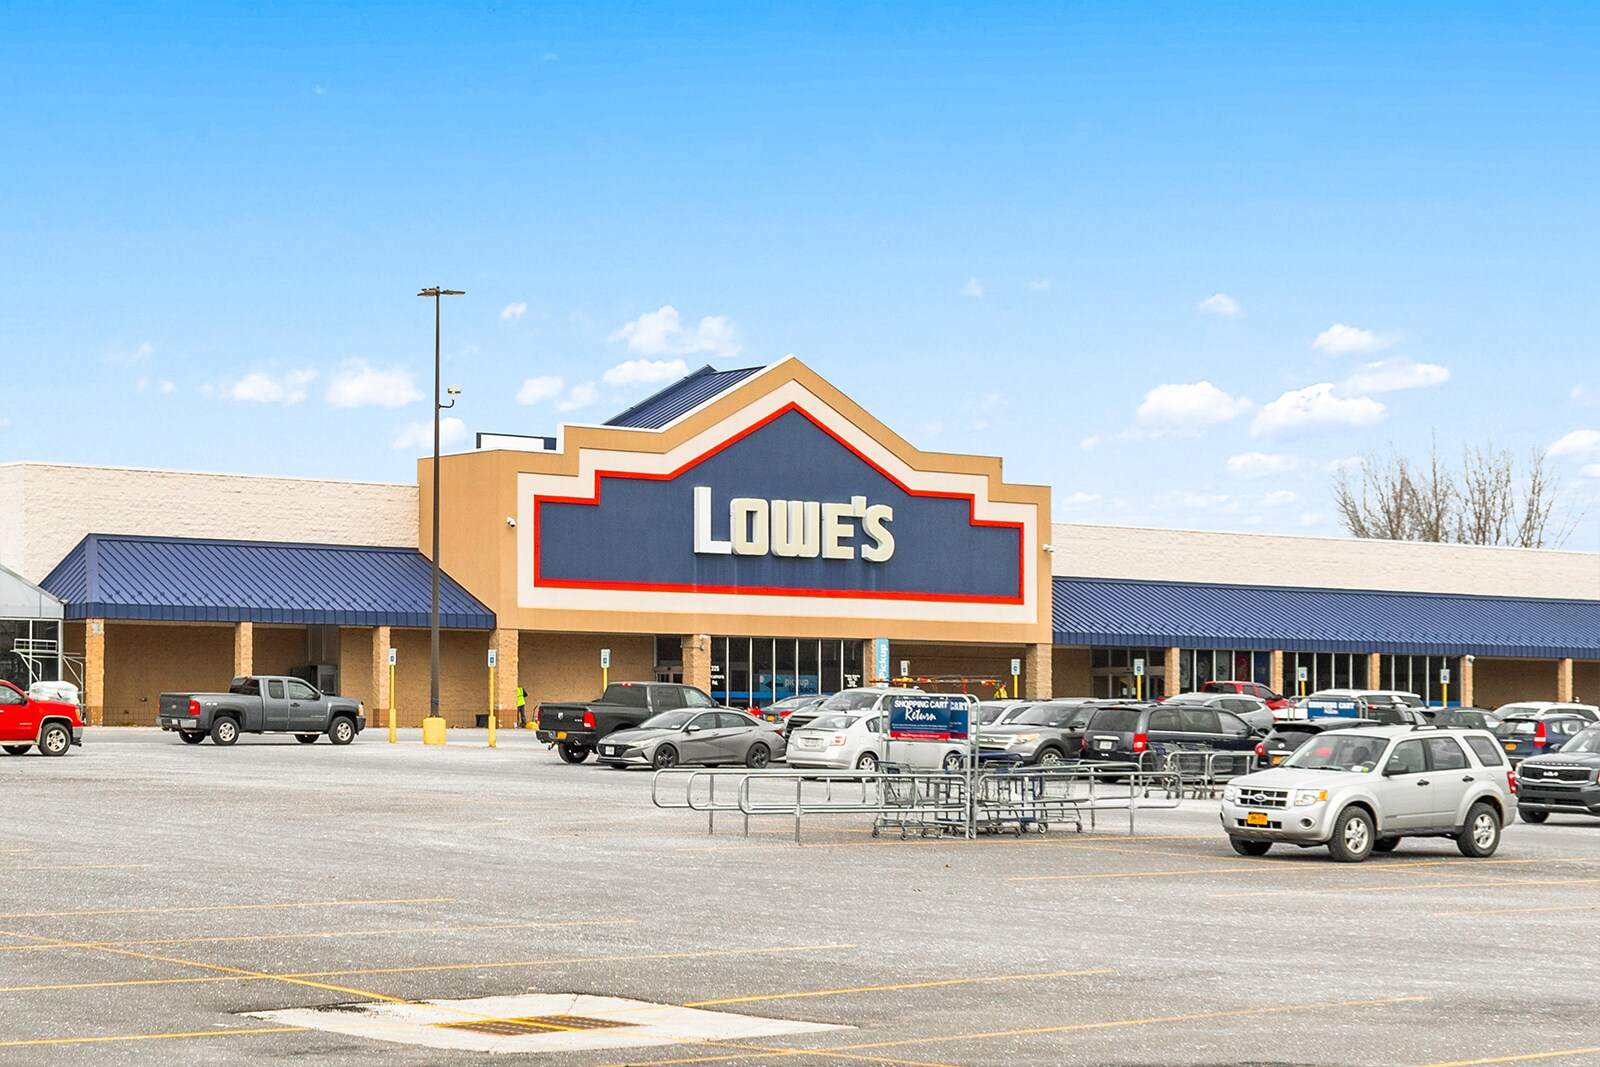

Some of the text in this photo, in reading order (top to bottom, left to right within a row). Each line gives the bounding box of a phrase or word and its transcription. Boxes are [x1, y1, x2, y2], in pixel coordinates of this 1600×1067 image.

[693, 486, 896, 563] LOWE'S
[878, 643, 888, 680] Pickup
[894, 700, 949, 709] SHOPPING CART
[904, 705, 937, 722] Return
